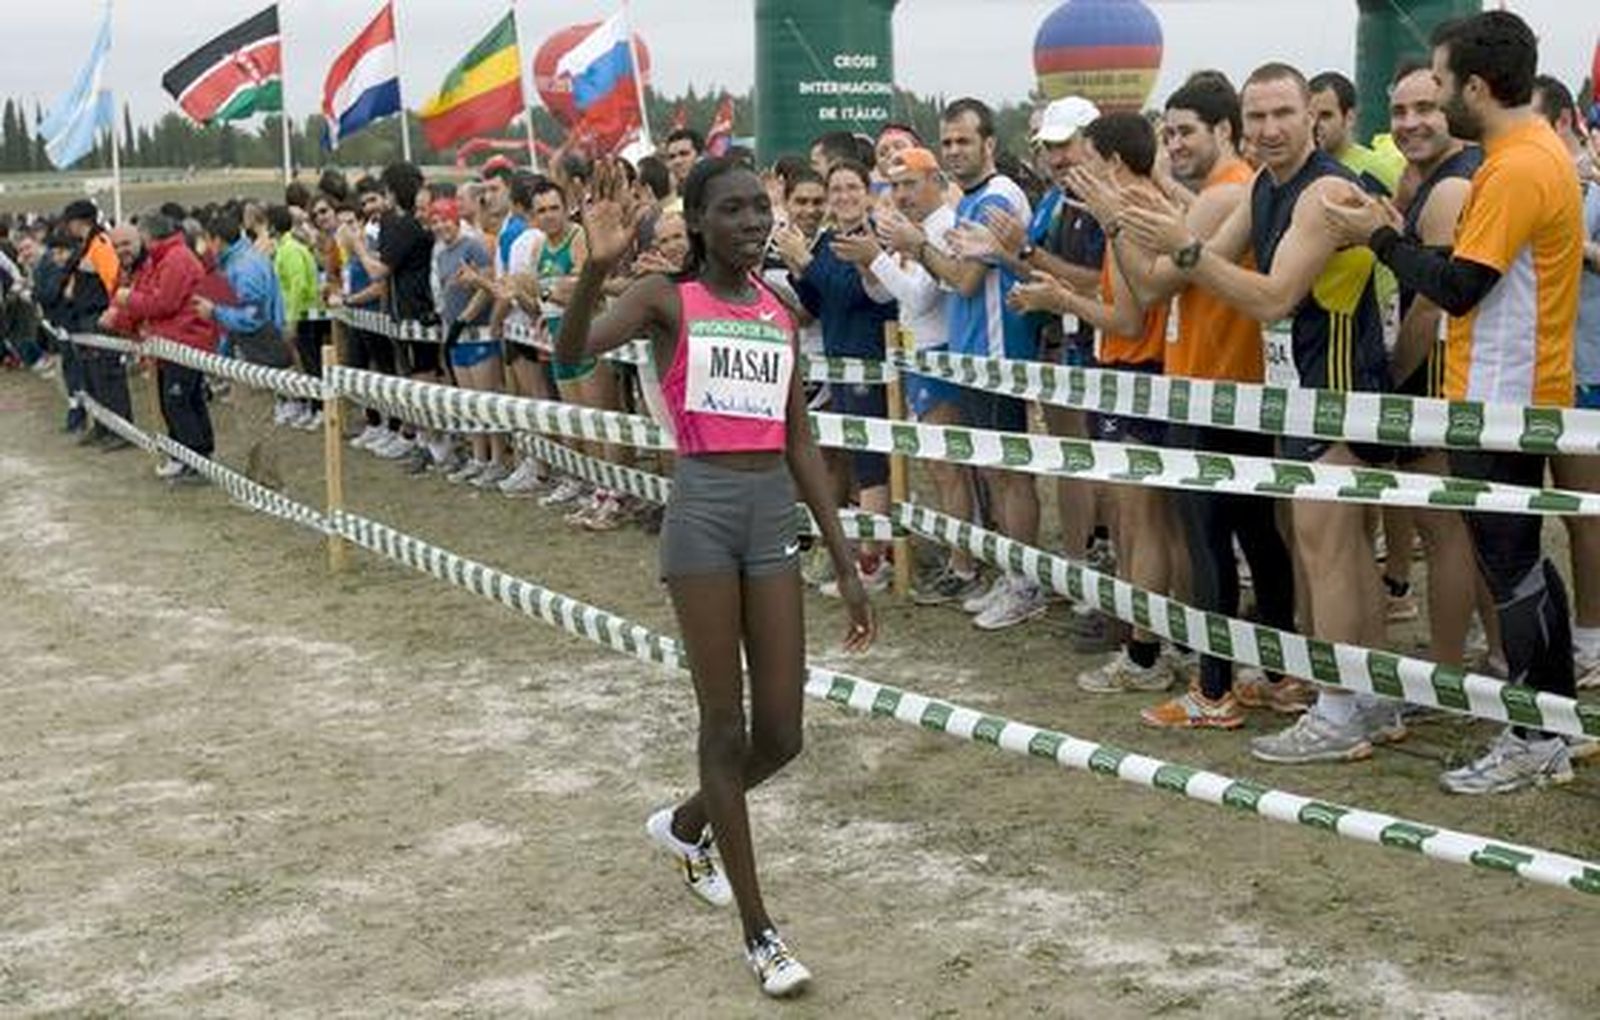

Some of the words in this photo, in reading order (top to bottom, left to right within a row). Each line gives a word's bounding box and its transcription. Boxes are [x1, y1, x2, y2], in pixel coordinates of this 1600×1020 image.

[834, 54, 877, 69] CROSS
[819, 107, 837, 119] DE
[710, 347, 779, 384] MASAI
